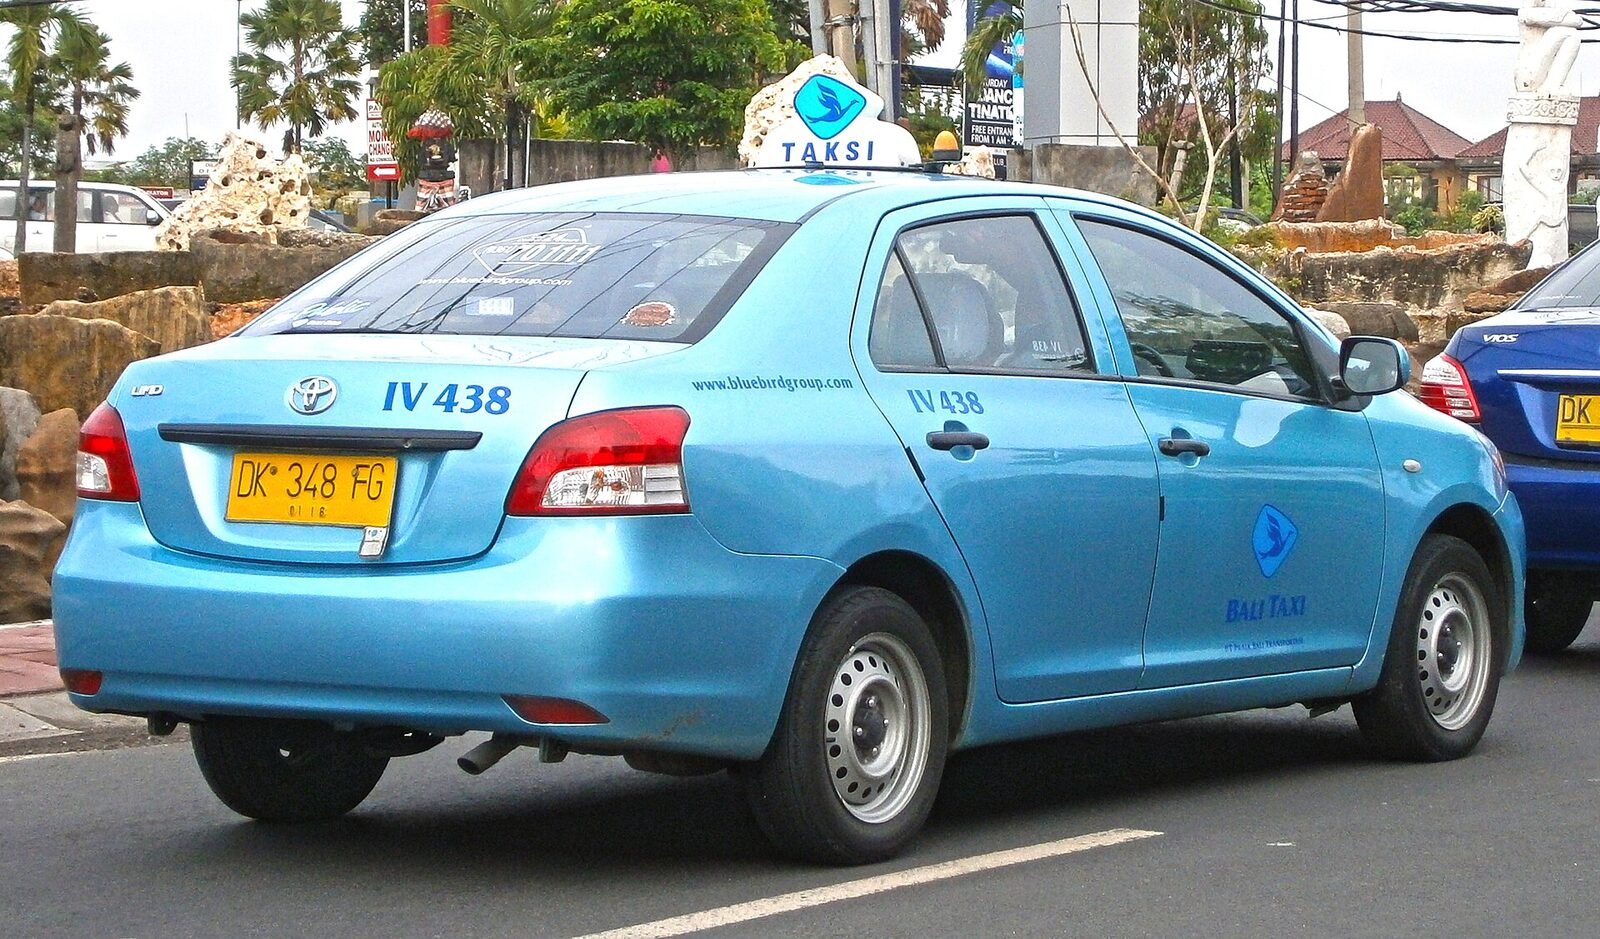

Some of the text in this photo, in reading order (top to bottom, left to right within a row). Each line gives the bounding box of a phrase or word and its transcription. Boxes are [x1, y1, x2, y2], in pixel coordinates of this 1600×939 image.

[983, 78, 1008, 88] URDAY
[369, 130, 389, 143] MON
[971, 125, 986, 134] FREE
[987, 126, 1014, 137] ENTRAN
[971, 134, 990, 143] FROM
[996, 135, 1006, 144] AM
[369, 143, 391, 155] CHANG
[781, 141, 874, 162] TAKSI
[539, 244, 602, 263] 1111
[1483, 333, 1519, 343] VIOS
[692, 375, 853, 393] www.bluebirdgroup.com
[382, 382, 512, 416] IV 438
[907, 389, 985, 415] IV 438
[1561, 397, 1592, 424] DK
[237, 460, 385, 501] DK 348 FG
[1225, 594, 1306, 623] BALI TAXI
